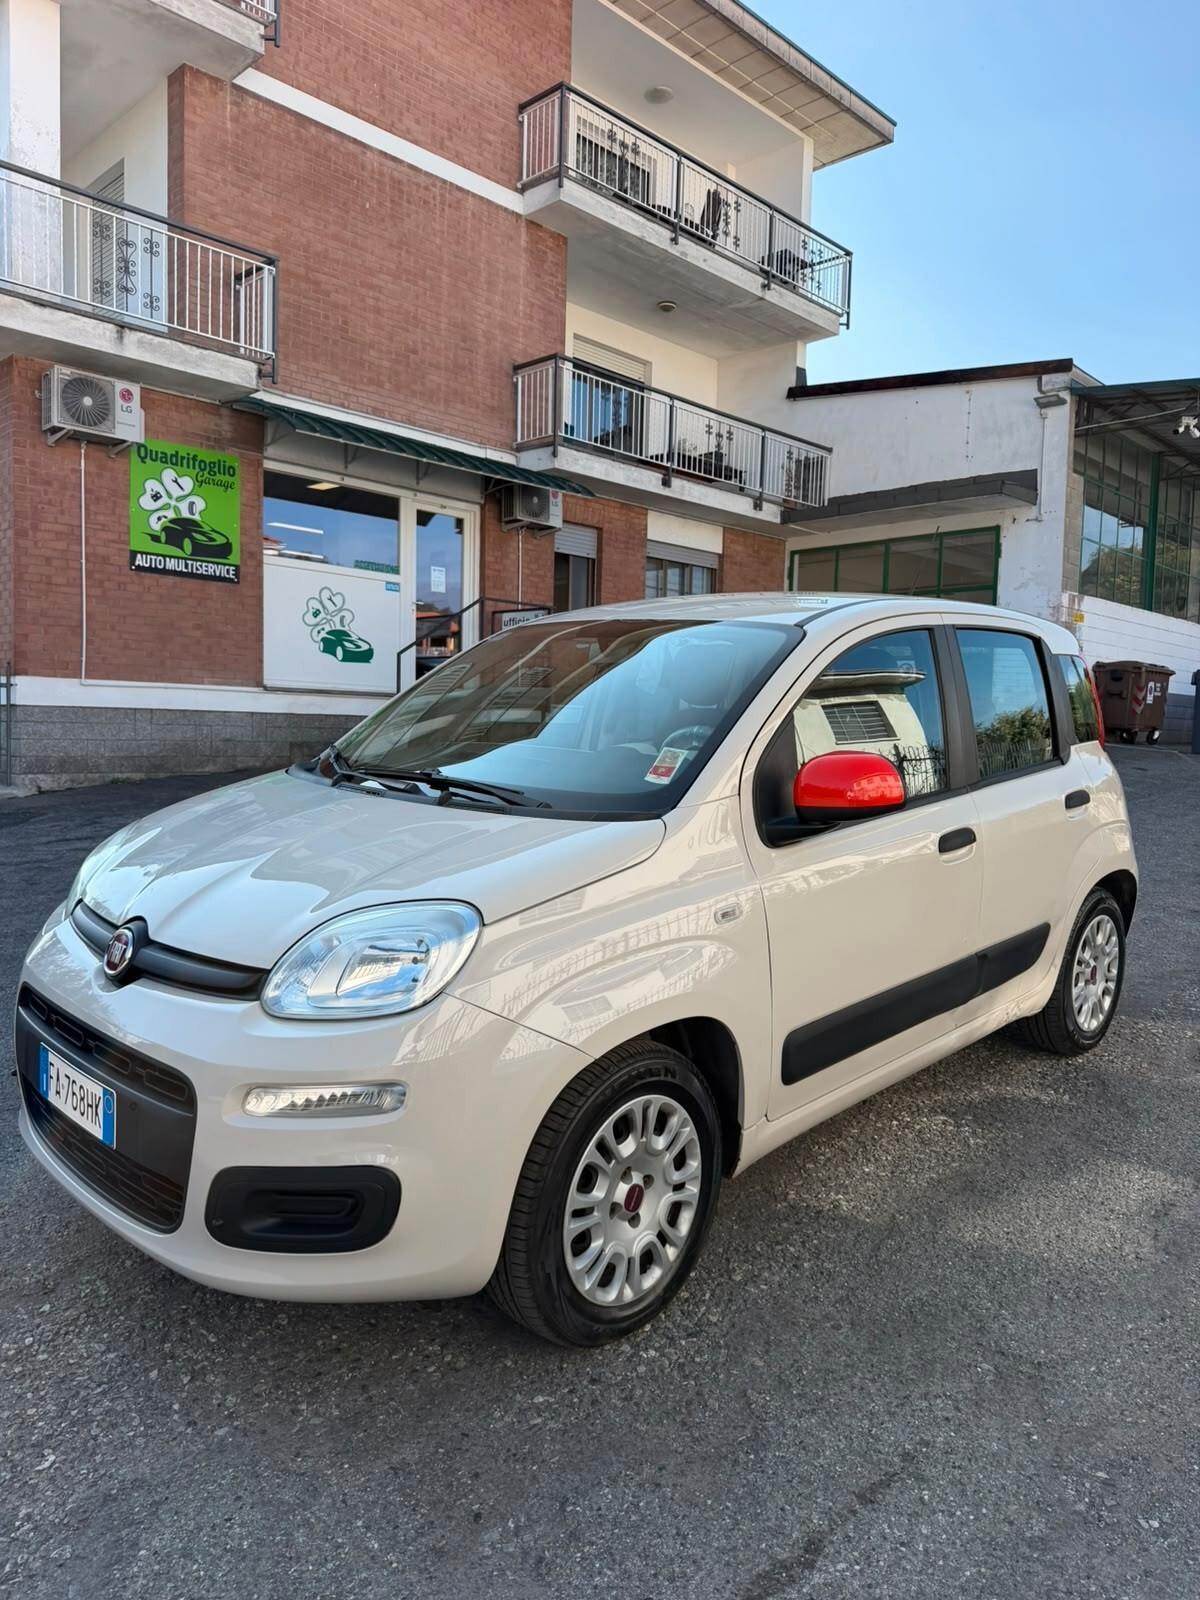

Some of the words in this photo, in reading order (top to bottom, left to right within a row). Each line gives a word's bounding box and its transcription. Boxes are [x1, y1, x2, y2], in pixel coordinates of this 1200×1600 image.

[120, 403, 132, 414] LG
[137, 443, 236, 477] Quadrifoglio
[195, 471, 236, 493] Garage
[135, 553, 164, 569] AUTO
[165, 558, 236, 579] MULTISERVICE
